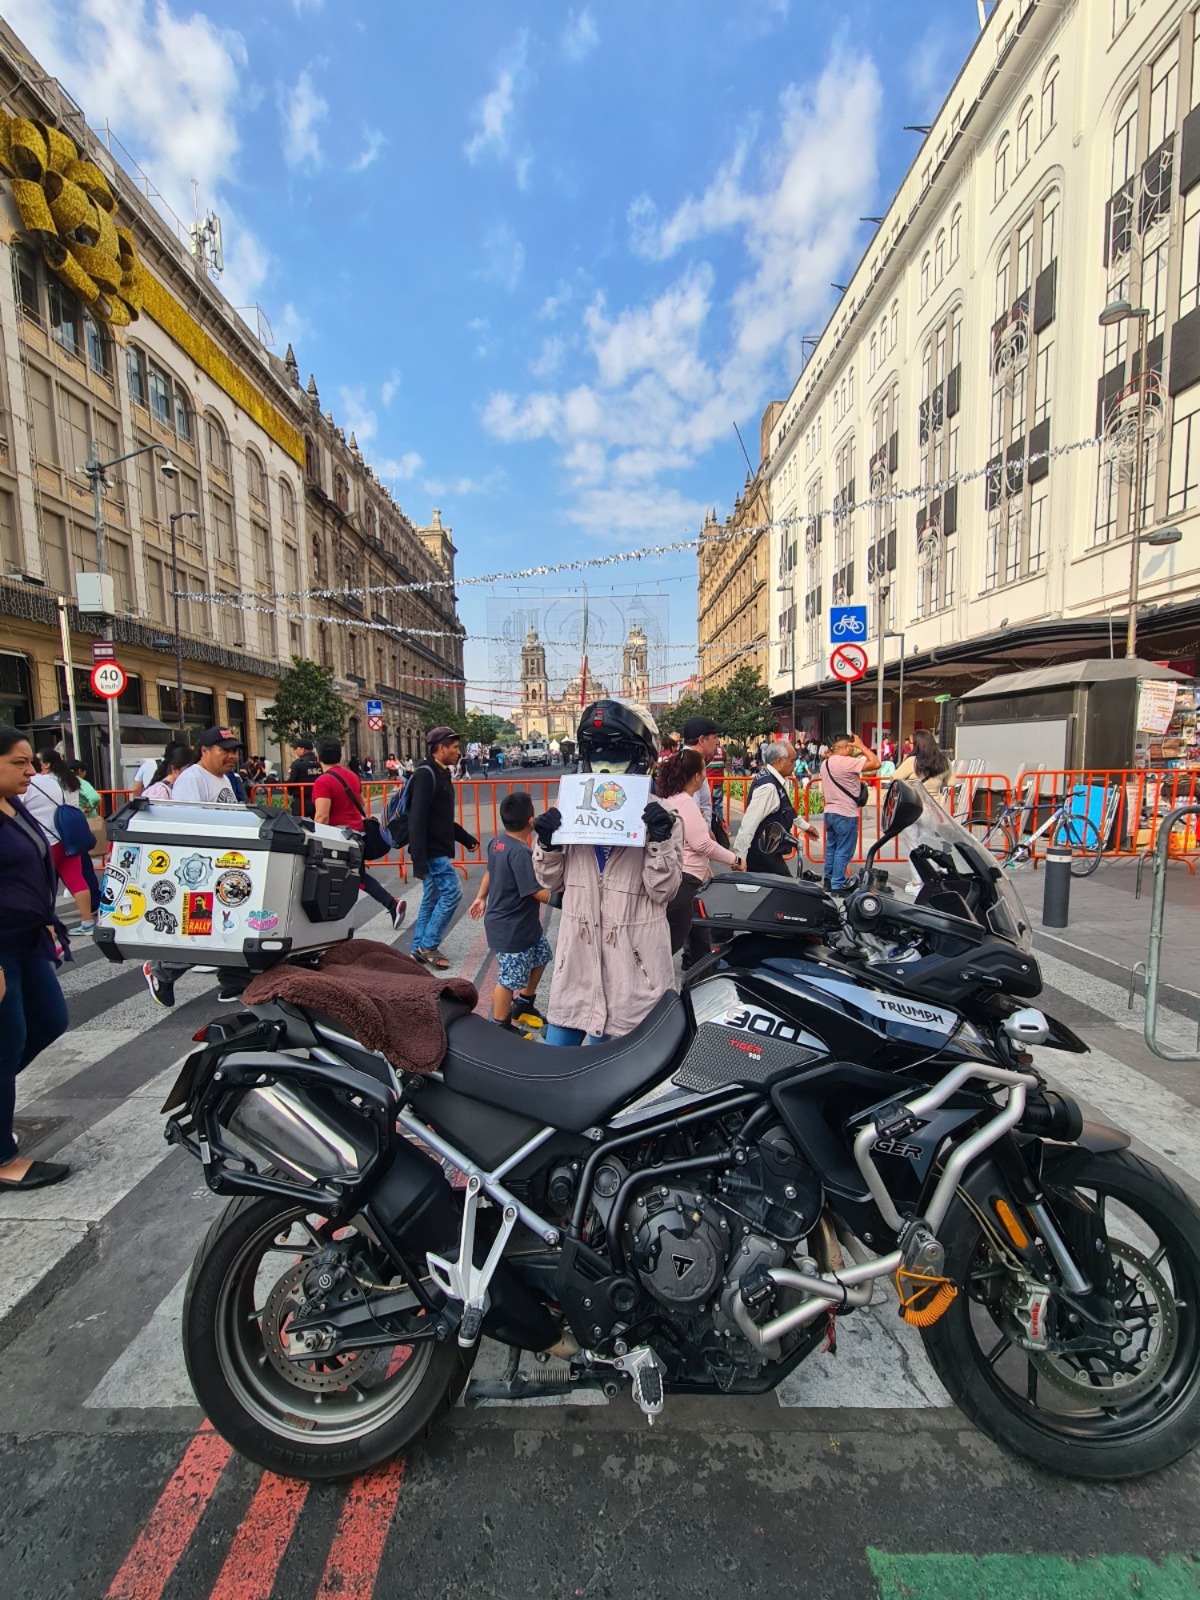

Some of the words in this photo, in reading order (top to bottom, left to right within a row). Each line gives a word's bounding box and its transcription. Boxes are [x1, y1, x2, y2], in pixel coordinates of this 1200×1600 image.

[100, 670, 118, 681] 40
[574, 812, 625, 831] AÑOS
[189, 920, 212, 930] RALLY
[876, 999, 945, 1024] TRIUMPH
[729, 1039, 763, 1053] TIGER
[749, 1052, 761, 1060] 900
[1032, 1302, 1041, 1337] brembo
